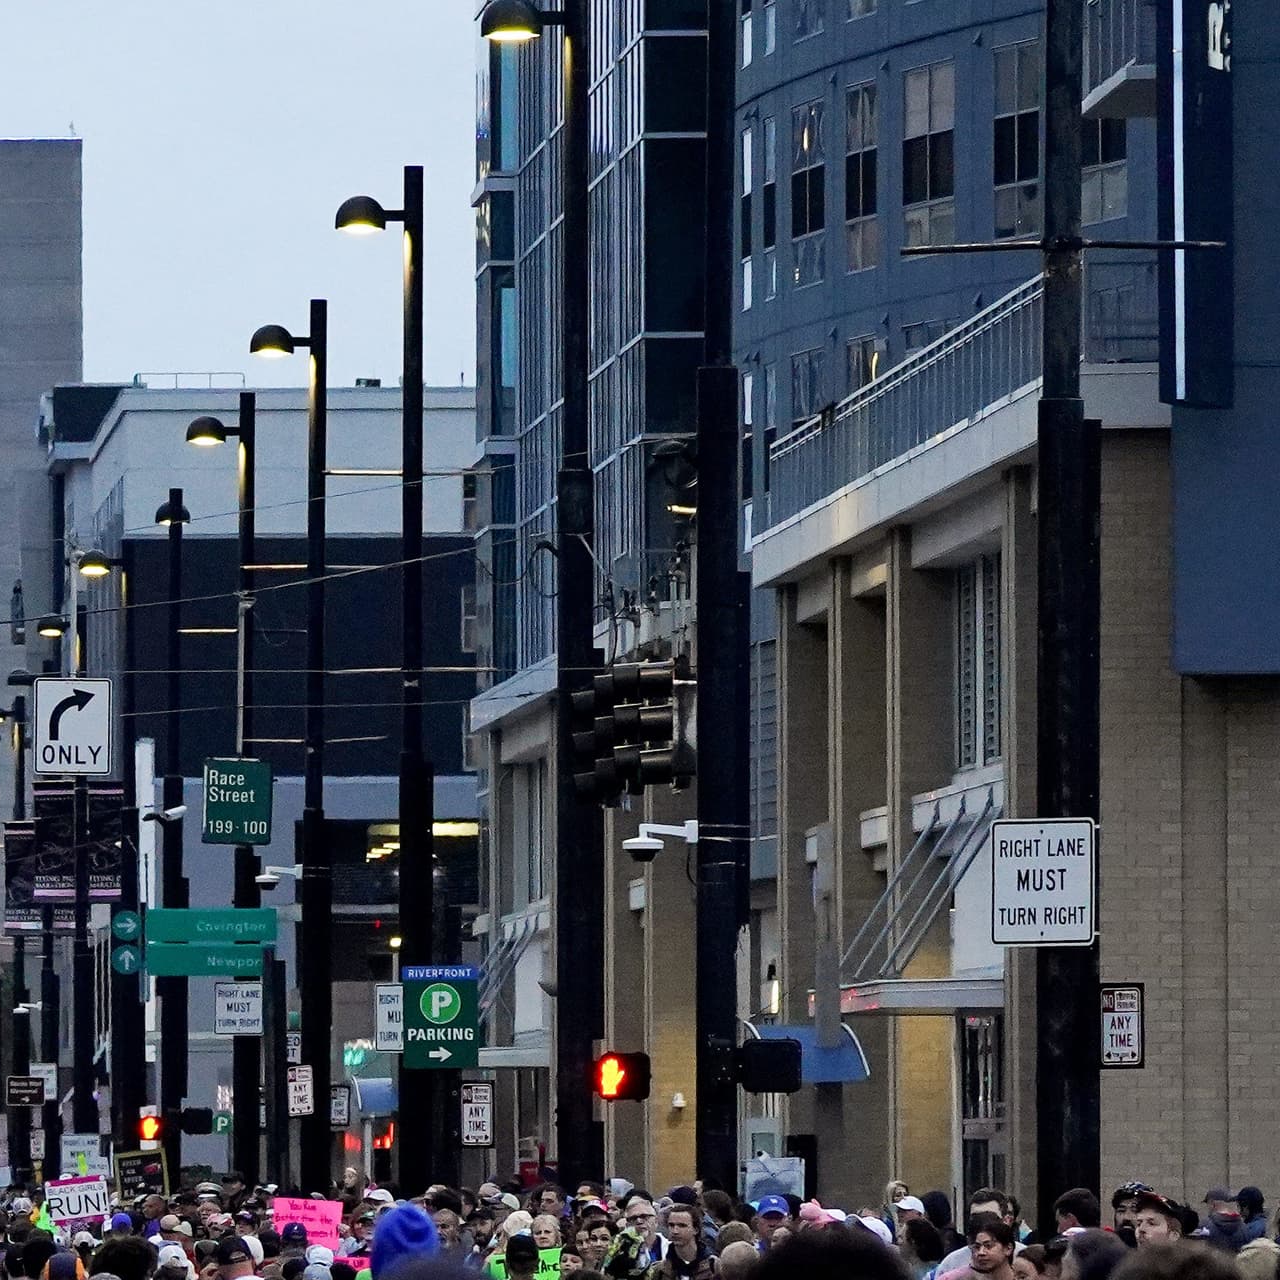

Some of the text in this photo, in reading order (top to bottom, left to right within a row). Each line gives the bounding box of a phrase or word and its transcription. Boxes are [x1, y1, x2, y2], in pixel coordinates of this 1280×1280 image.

[42, 745, 102, 765] ONLY
[209, 769, 245, 786] Race
[209, 786, 255, 803] Street
[999, 838, 1086, 858] RIGHT LANE
[1017, 869, 1067, 892] MUST
[999, 906, 1086, 926] TURN RIGHT
[196, 921, 266, 933] Covington
[207, 957, 262, 968] Newpor
[407, 968, 472, 978] RIVERFRONT
[217, 990, 260, 999] RIGHT LANE
[226, 1003, 252, 1013] MUST
[431, 991, 453, 1018] P
[217, 1018, 236, 1027] TURN
[387, 1011, 401, 1024] MU
[1110, 1016, 1131, 1030] ANY
[407, 1028, 474, 1041] PARKING
[1109, 1033, 1133, 1048] TIME
[294, 1084, 307, 1092] ANY
[293, 1095, 308, 1104] TIME
[469, 1106, 486, 1118] ANY
[217, 1116, 228, 1131] P
[468, 1120, 487, 1131] TIME
[47, 1184, 104, 1196] BLACK GIRLS
[47, 1191, 108, 1218] RUN!
